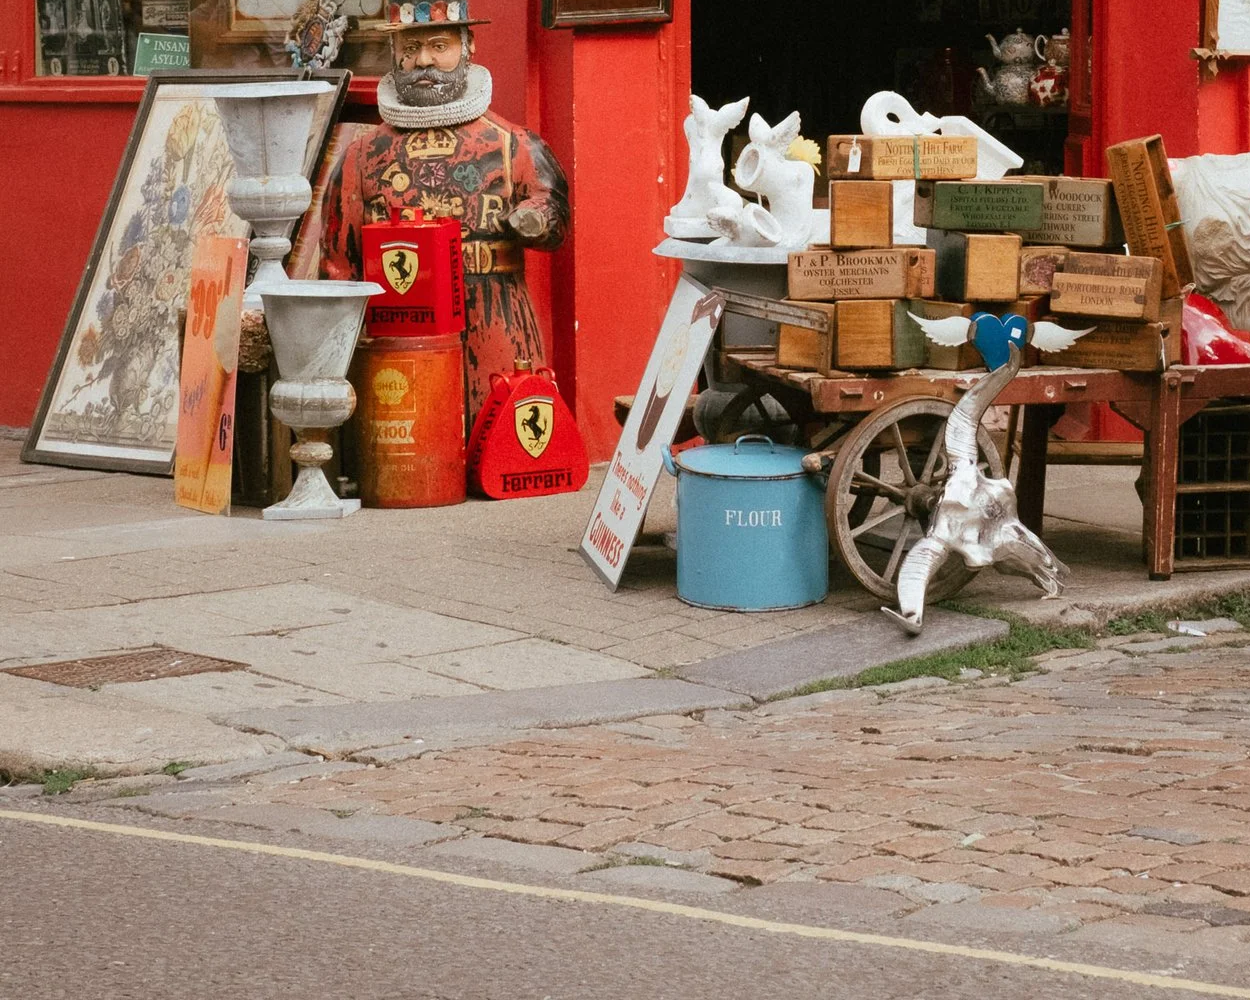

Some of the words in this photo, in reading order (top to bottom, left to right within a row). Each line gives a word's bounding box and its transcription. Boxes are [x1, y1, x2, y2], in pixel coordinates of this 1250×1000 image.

[923, 141, 940, 155] HILL
[900, 157, 915, 165] EGG
[985, 185, 1022, 194] KIPPING
[1049, 189, 1102, 202] WOODCOCK
[1056, 203, 1086, 212] CURERS
[1072, 214, 1100, 223] STREET
[1144, 215, 1159, 240] HILL
[1028, 232, 1060, 241] LONDON
[794, 255, 807, 267] T.
[809, 259, 817, 267] &
[820, 254, 832, 267] P.
[836, 253, 899, 266] BROOKMAN
[803, 268, 836, 277] OYSTER
[840, 267, 889, 276] MERCHANTS
[819, 277, 874, 286] COLCHESTER
[1066, 282, 1116, 293] PORTOBELLO
[1119, 285, 1142, 295] ROAD
[1080, 295, 1113, 305] LONDON
[371, 306, 436, 323] Ferrari
[375, 380, 406, 391] SHELL
[500, 468, 574, 493] Ferrari
[625, 472, 648, 511] nothing
[609, 487, 621, 516] like
[725, 508, 783, 527] FLOUR
[589, 511, 625, 569] GUINNESS
